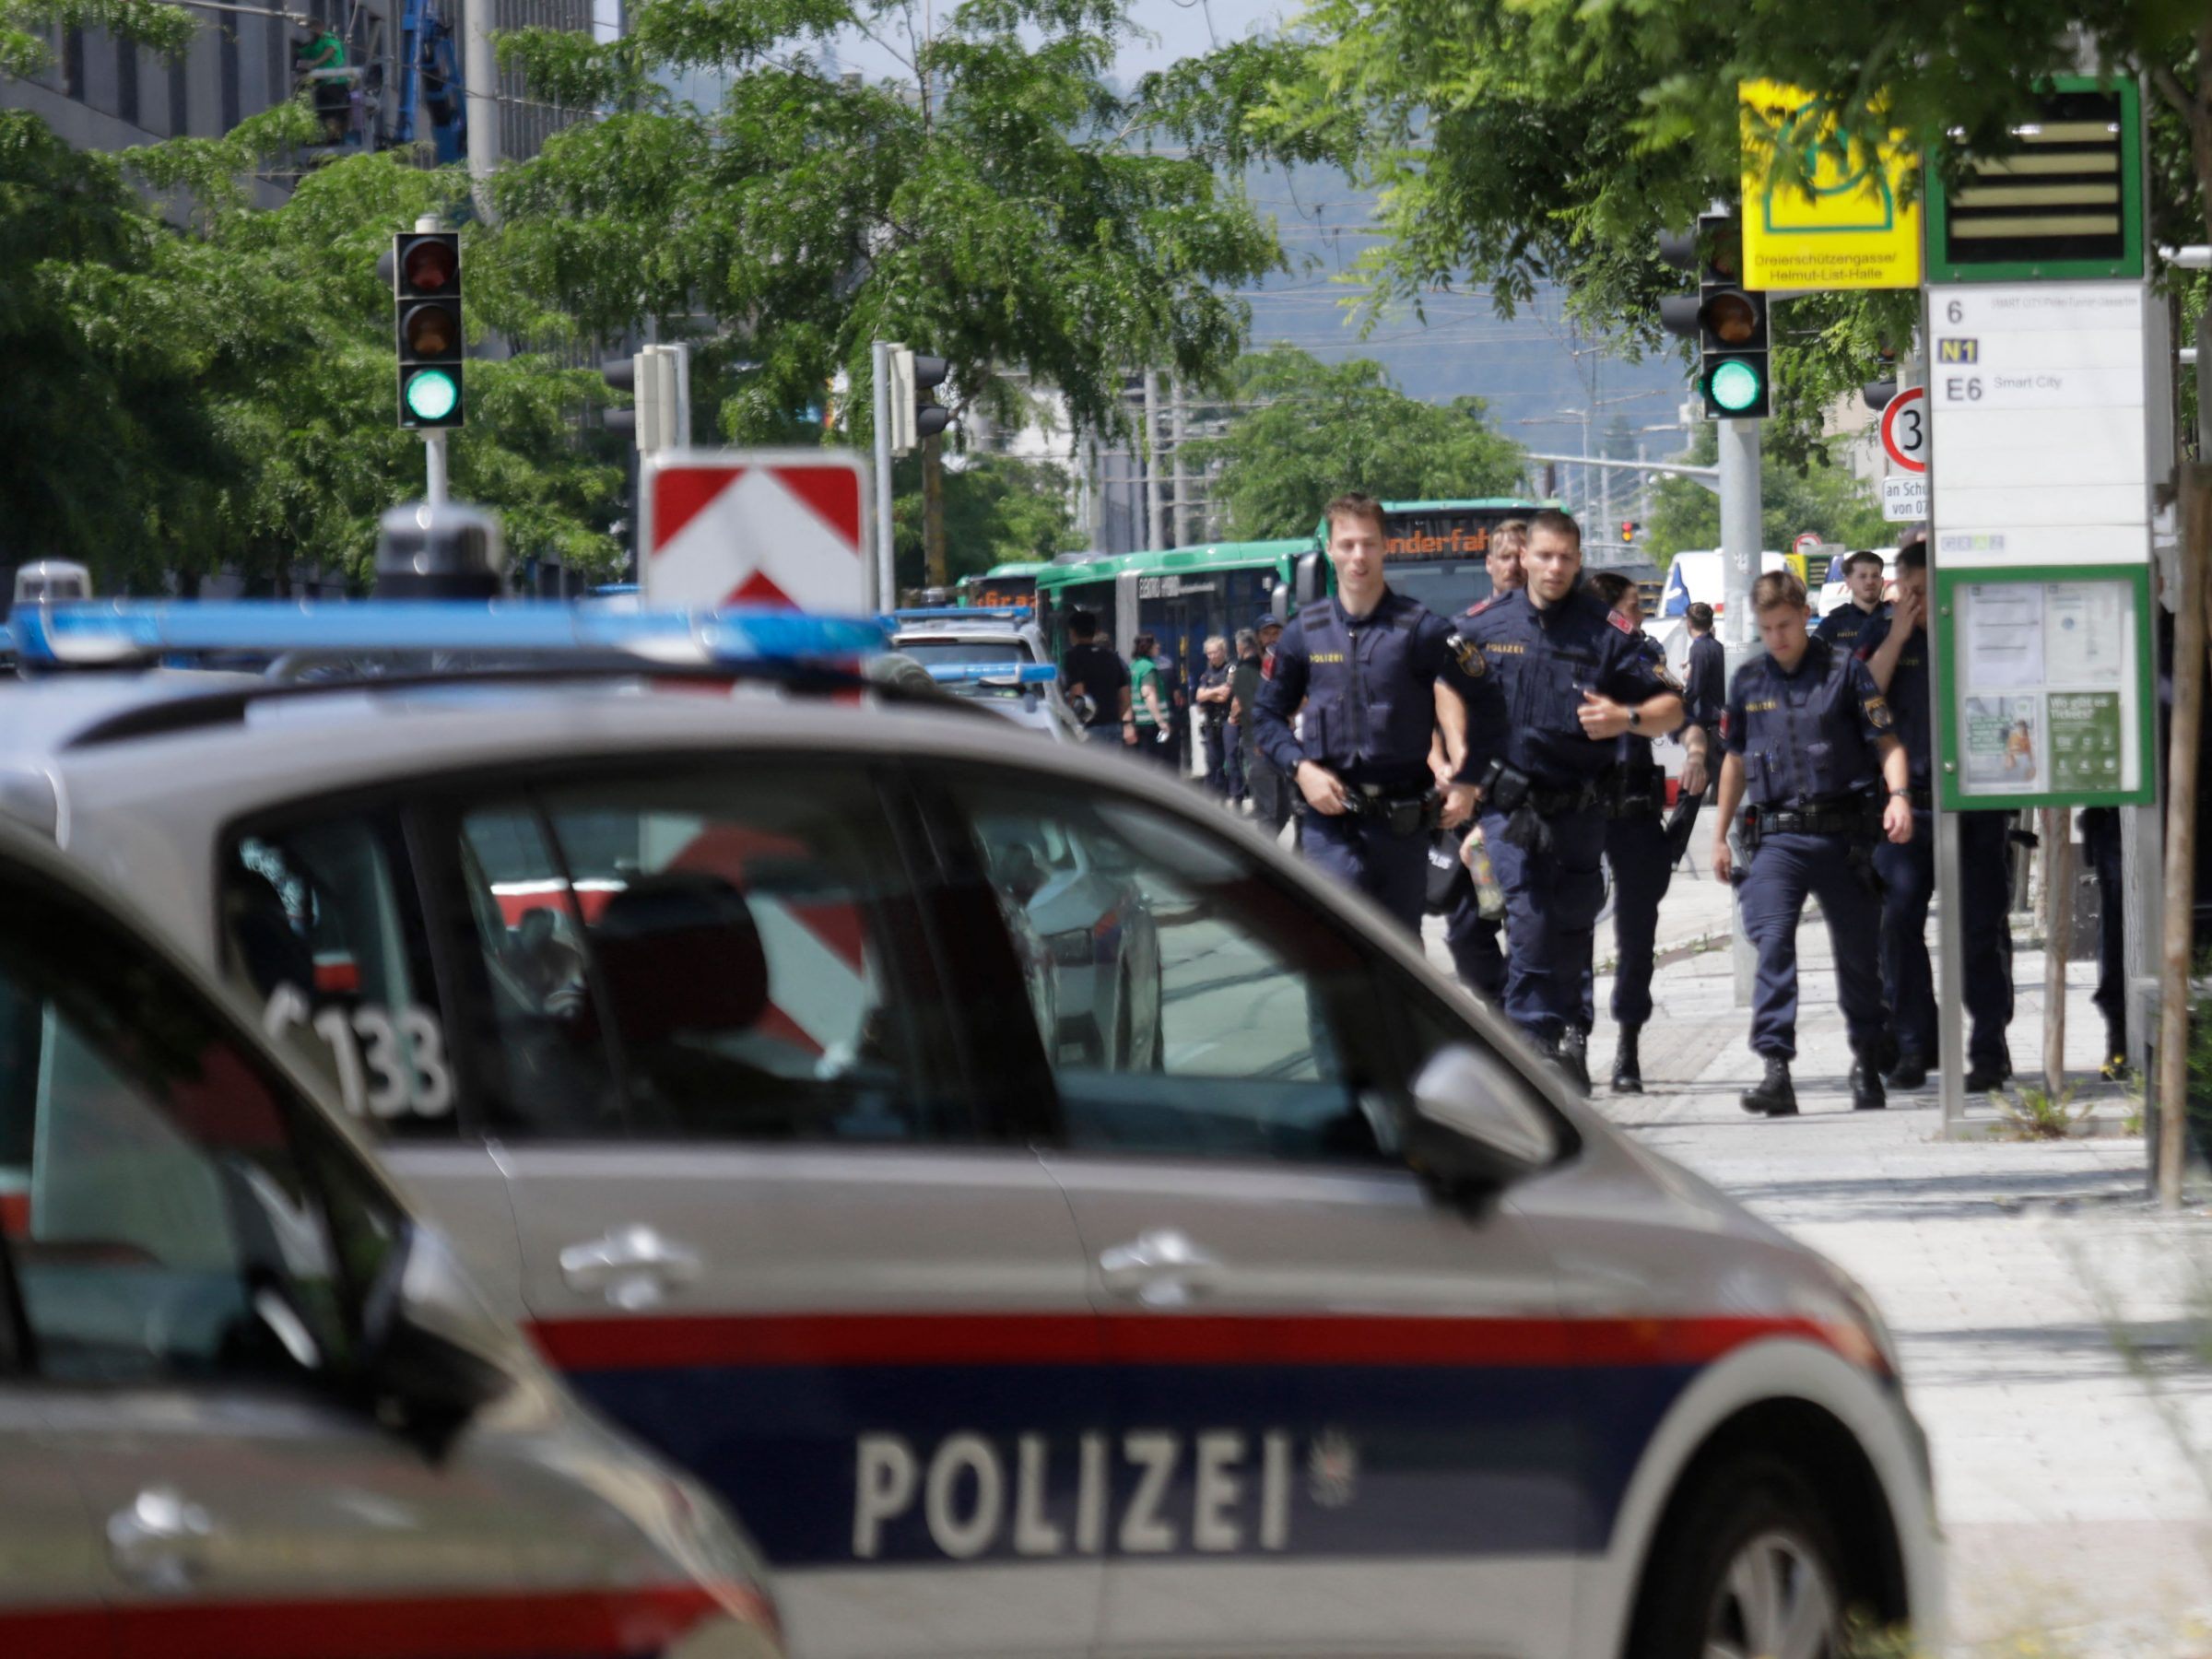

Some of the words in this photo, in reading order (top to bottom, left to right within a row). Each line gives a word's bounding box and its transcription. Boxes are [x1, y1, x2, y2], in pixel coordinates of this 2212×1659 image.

[1770, 268, 1883, 281] Helmut-List-Halle
[1947, 300, 1963, 323] 6
[1941, 339, 1976, 357] N1
[1947, 378, 1983, 401] E6
[1994, 377, 2032, 389] Smart
[2036, 376, 2063, 391] City
[1887, 486, 1900, 497] an
[1892, 503, 1912, 514] von
[1486, 642, 1524, 654] POLIZEI
[1310, 653, 1344, 663] POLIZEI
[312, 1007, 453, 1119] 133
[852, 1429, 1288, 1559] POLIZEI
